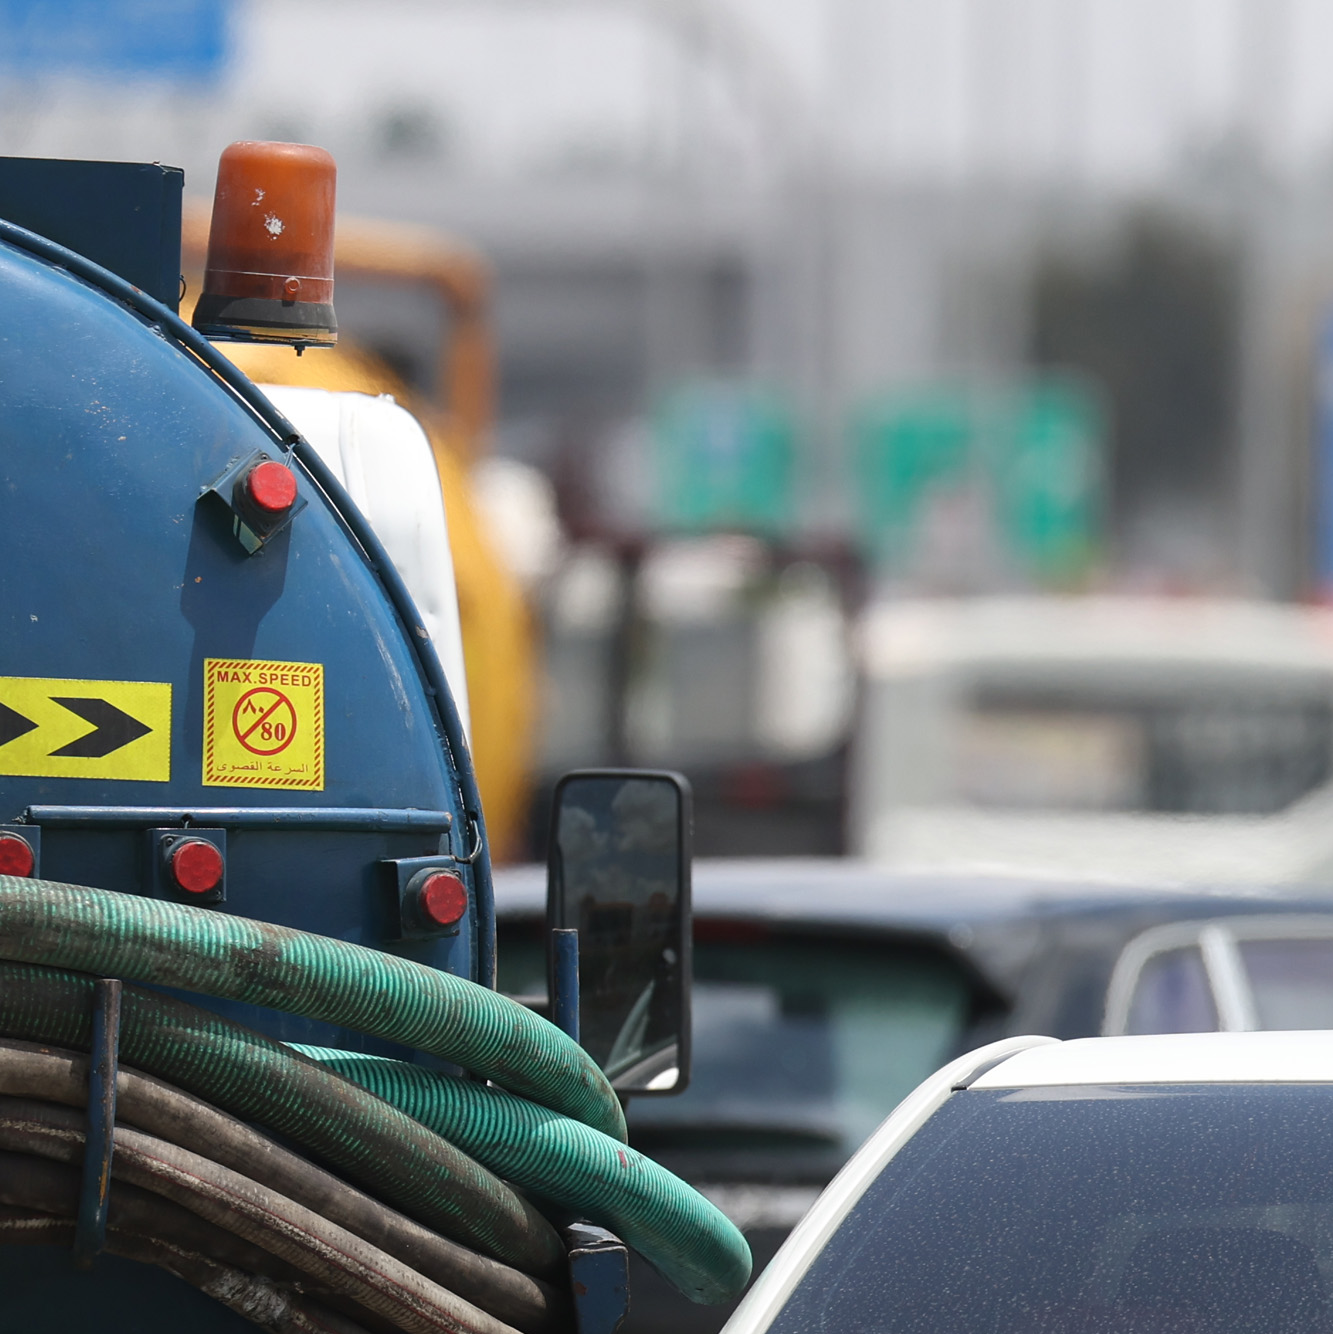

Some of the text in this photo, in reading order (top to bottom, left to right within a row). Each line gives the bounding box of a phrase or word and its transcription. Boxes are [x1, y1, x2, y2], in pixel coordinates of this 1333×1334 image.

[217, 671, 312, 687] MAX.SPEED
[243, 699, 265, 715] ٨٠
[261, 722, 286, 741] 80
[268, 762, 309, 775] السرعة
